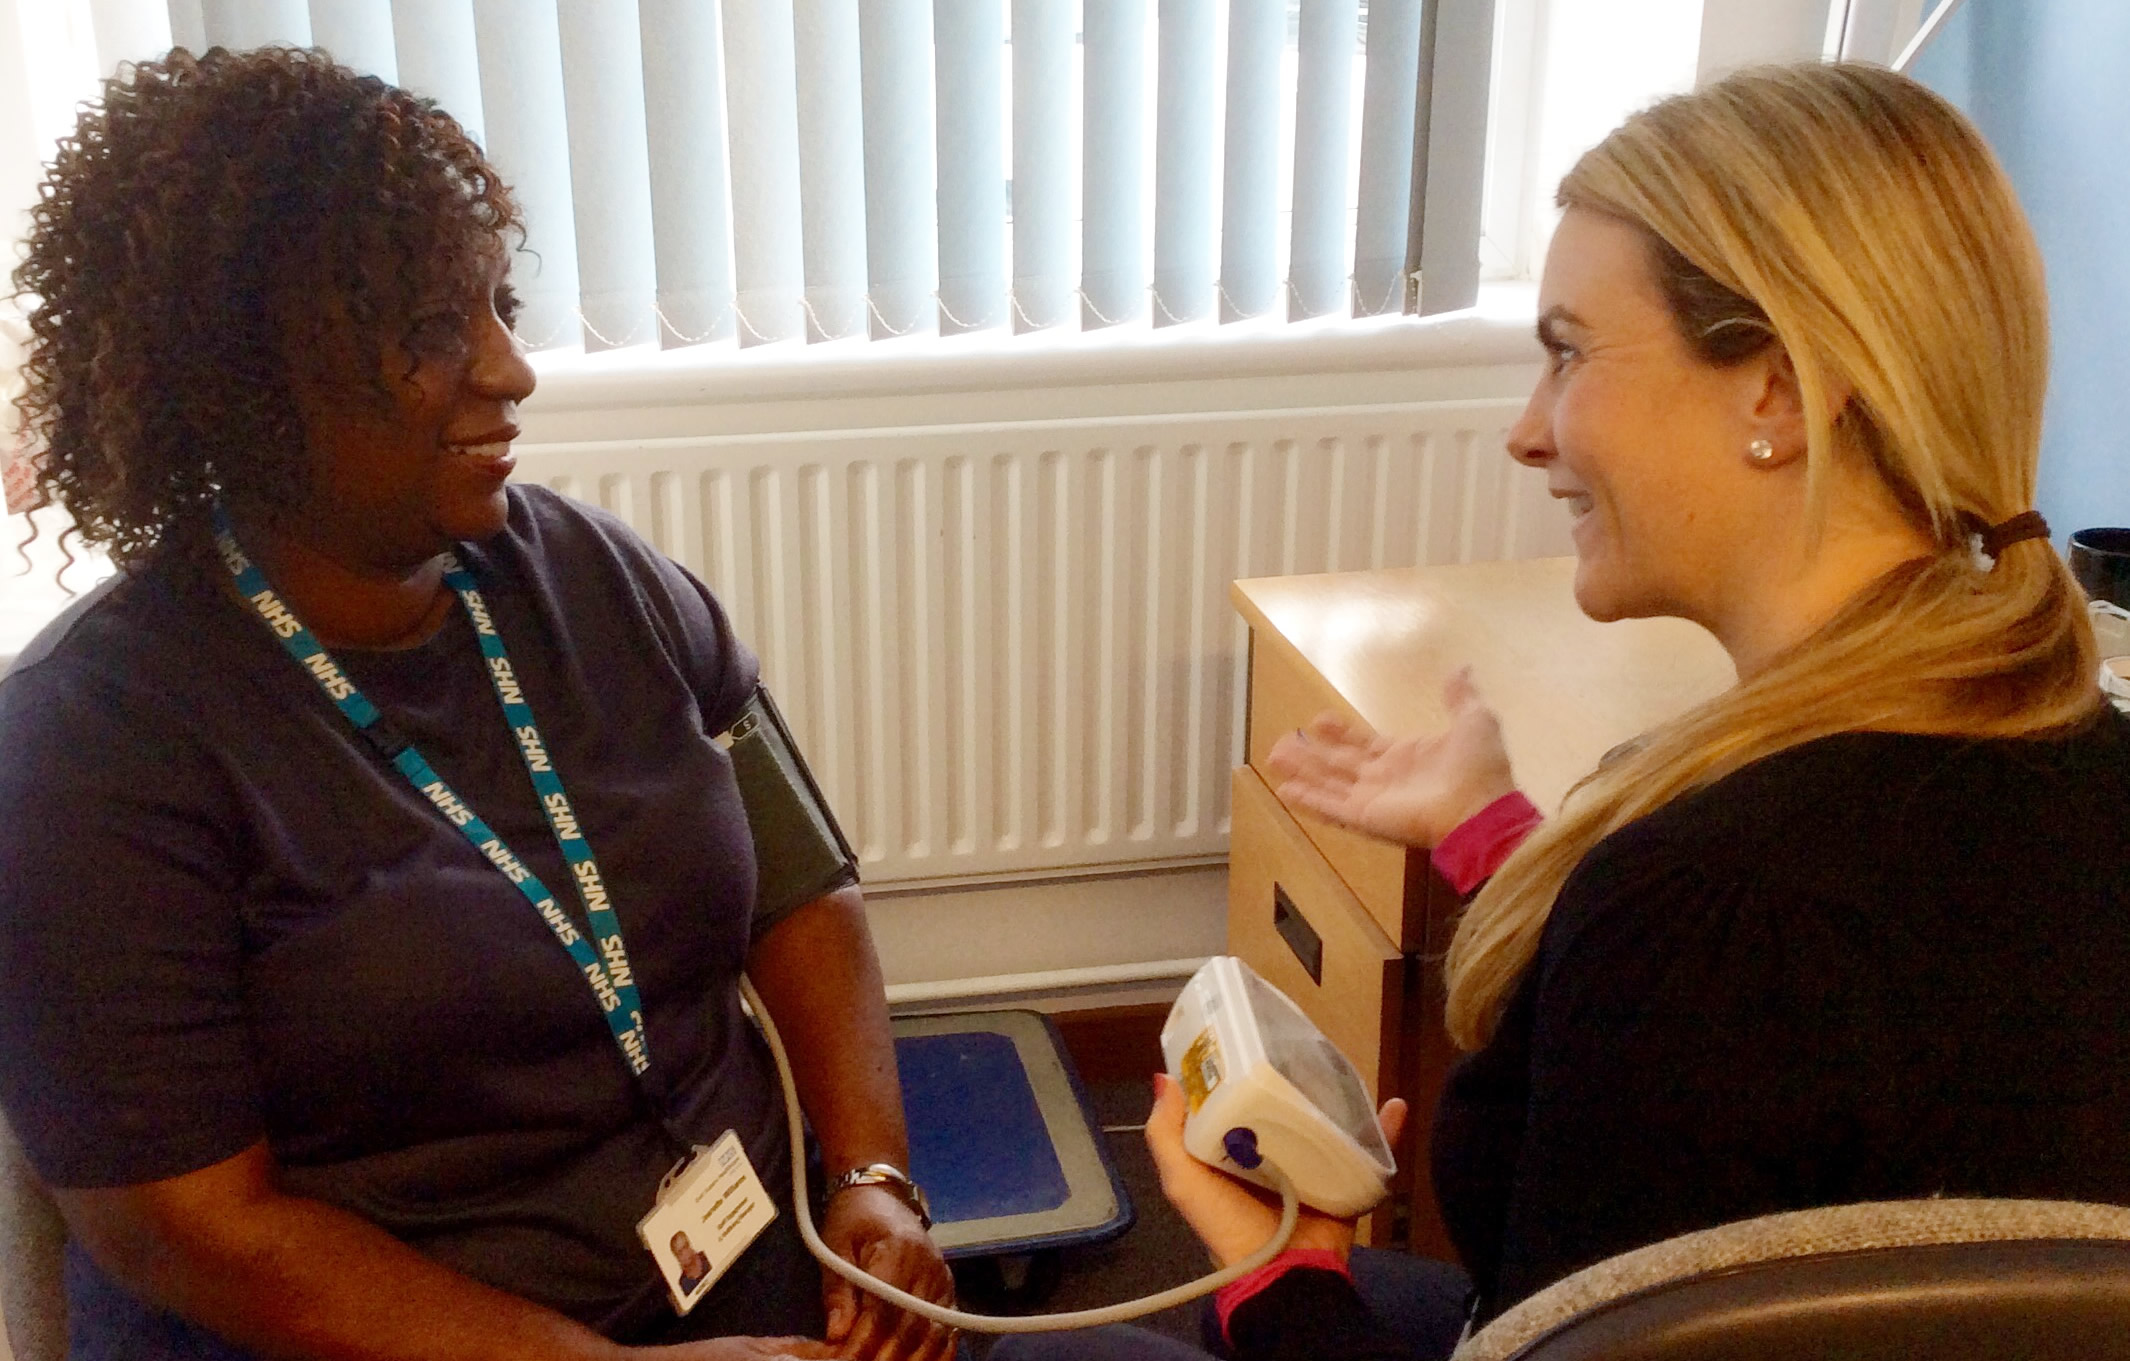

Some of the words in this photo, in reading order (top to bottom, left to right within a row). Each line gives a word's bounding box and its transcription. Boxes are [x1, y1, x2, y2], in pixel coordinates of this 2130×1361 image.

[250, 589, 303, 638] NHS
[462, 589, 497, 636] NHS
[303, 652, 357, 701] NHS
[489, 656, 525, 705] NHS
[515, 725, 553, 773] NHS
[422, 780, 475, 826] NHS
[543, 792, 582, 841] NHS
[480, 838, 532, 883] NHS
[573, 860, 611, 913] NHS
[536, 898, 581, 947] NHS
[600, 933, 634, 987] NHS
[583, 962, 622, 1012] NHS
